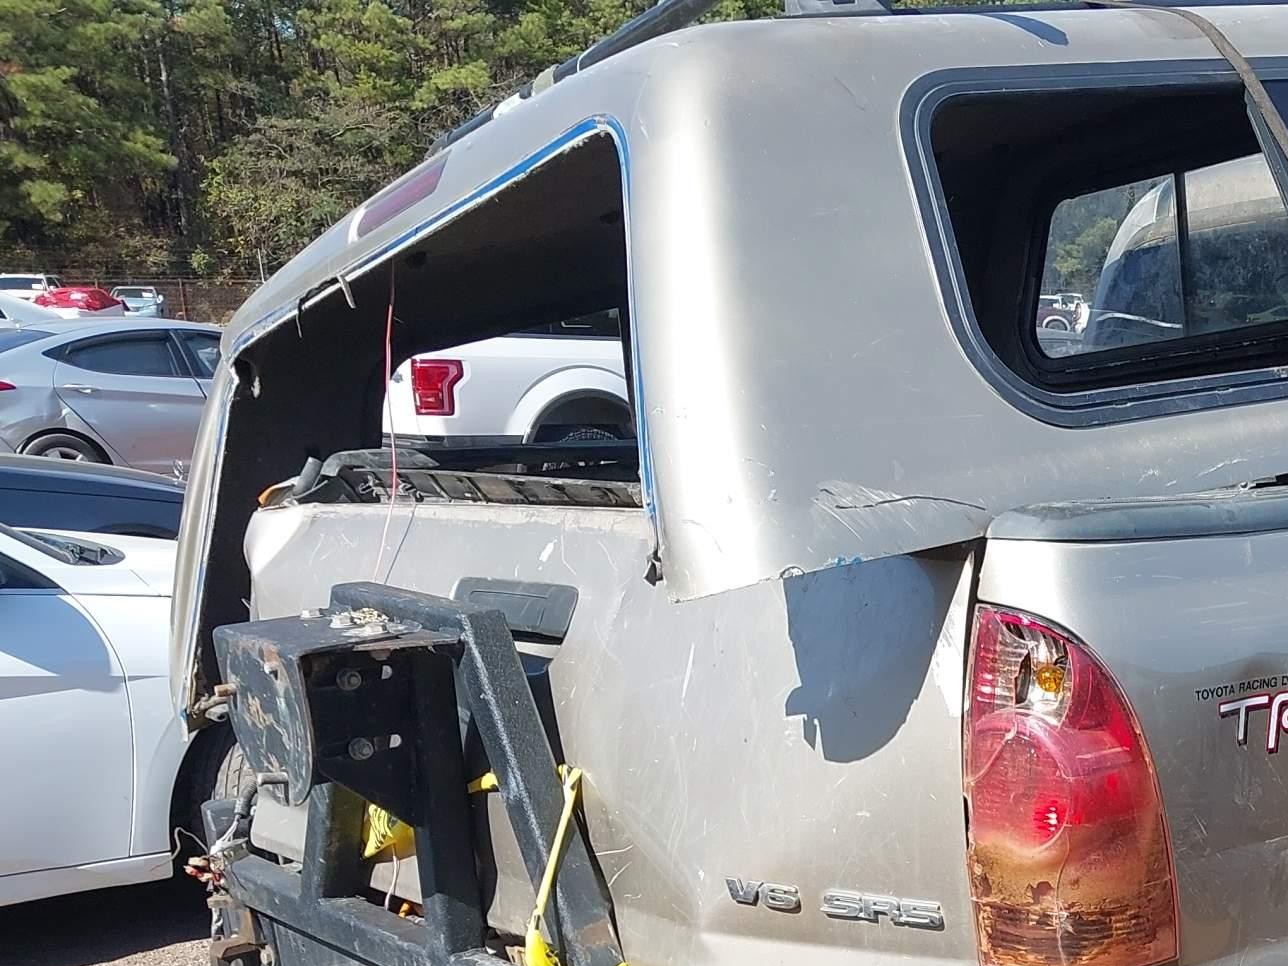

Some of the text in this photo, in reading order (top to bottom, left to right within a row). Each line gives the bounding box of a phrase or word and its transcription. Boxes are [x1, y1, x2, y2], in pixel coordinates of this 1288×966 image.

[1195, 684, 1236, 701] TOYOTA
[1238, 676, 1278, 692] RACING
[724, 877, 945, 931] V6 SR5
